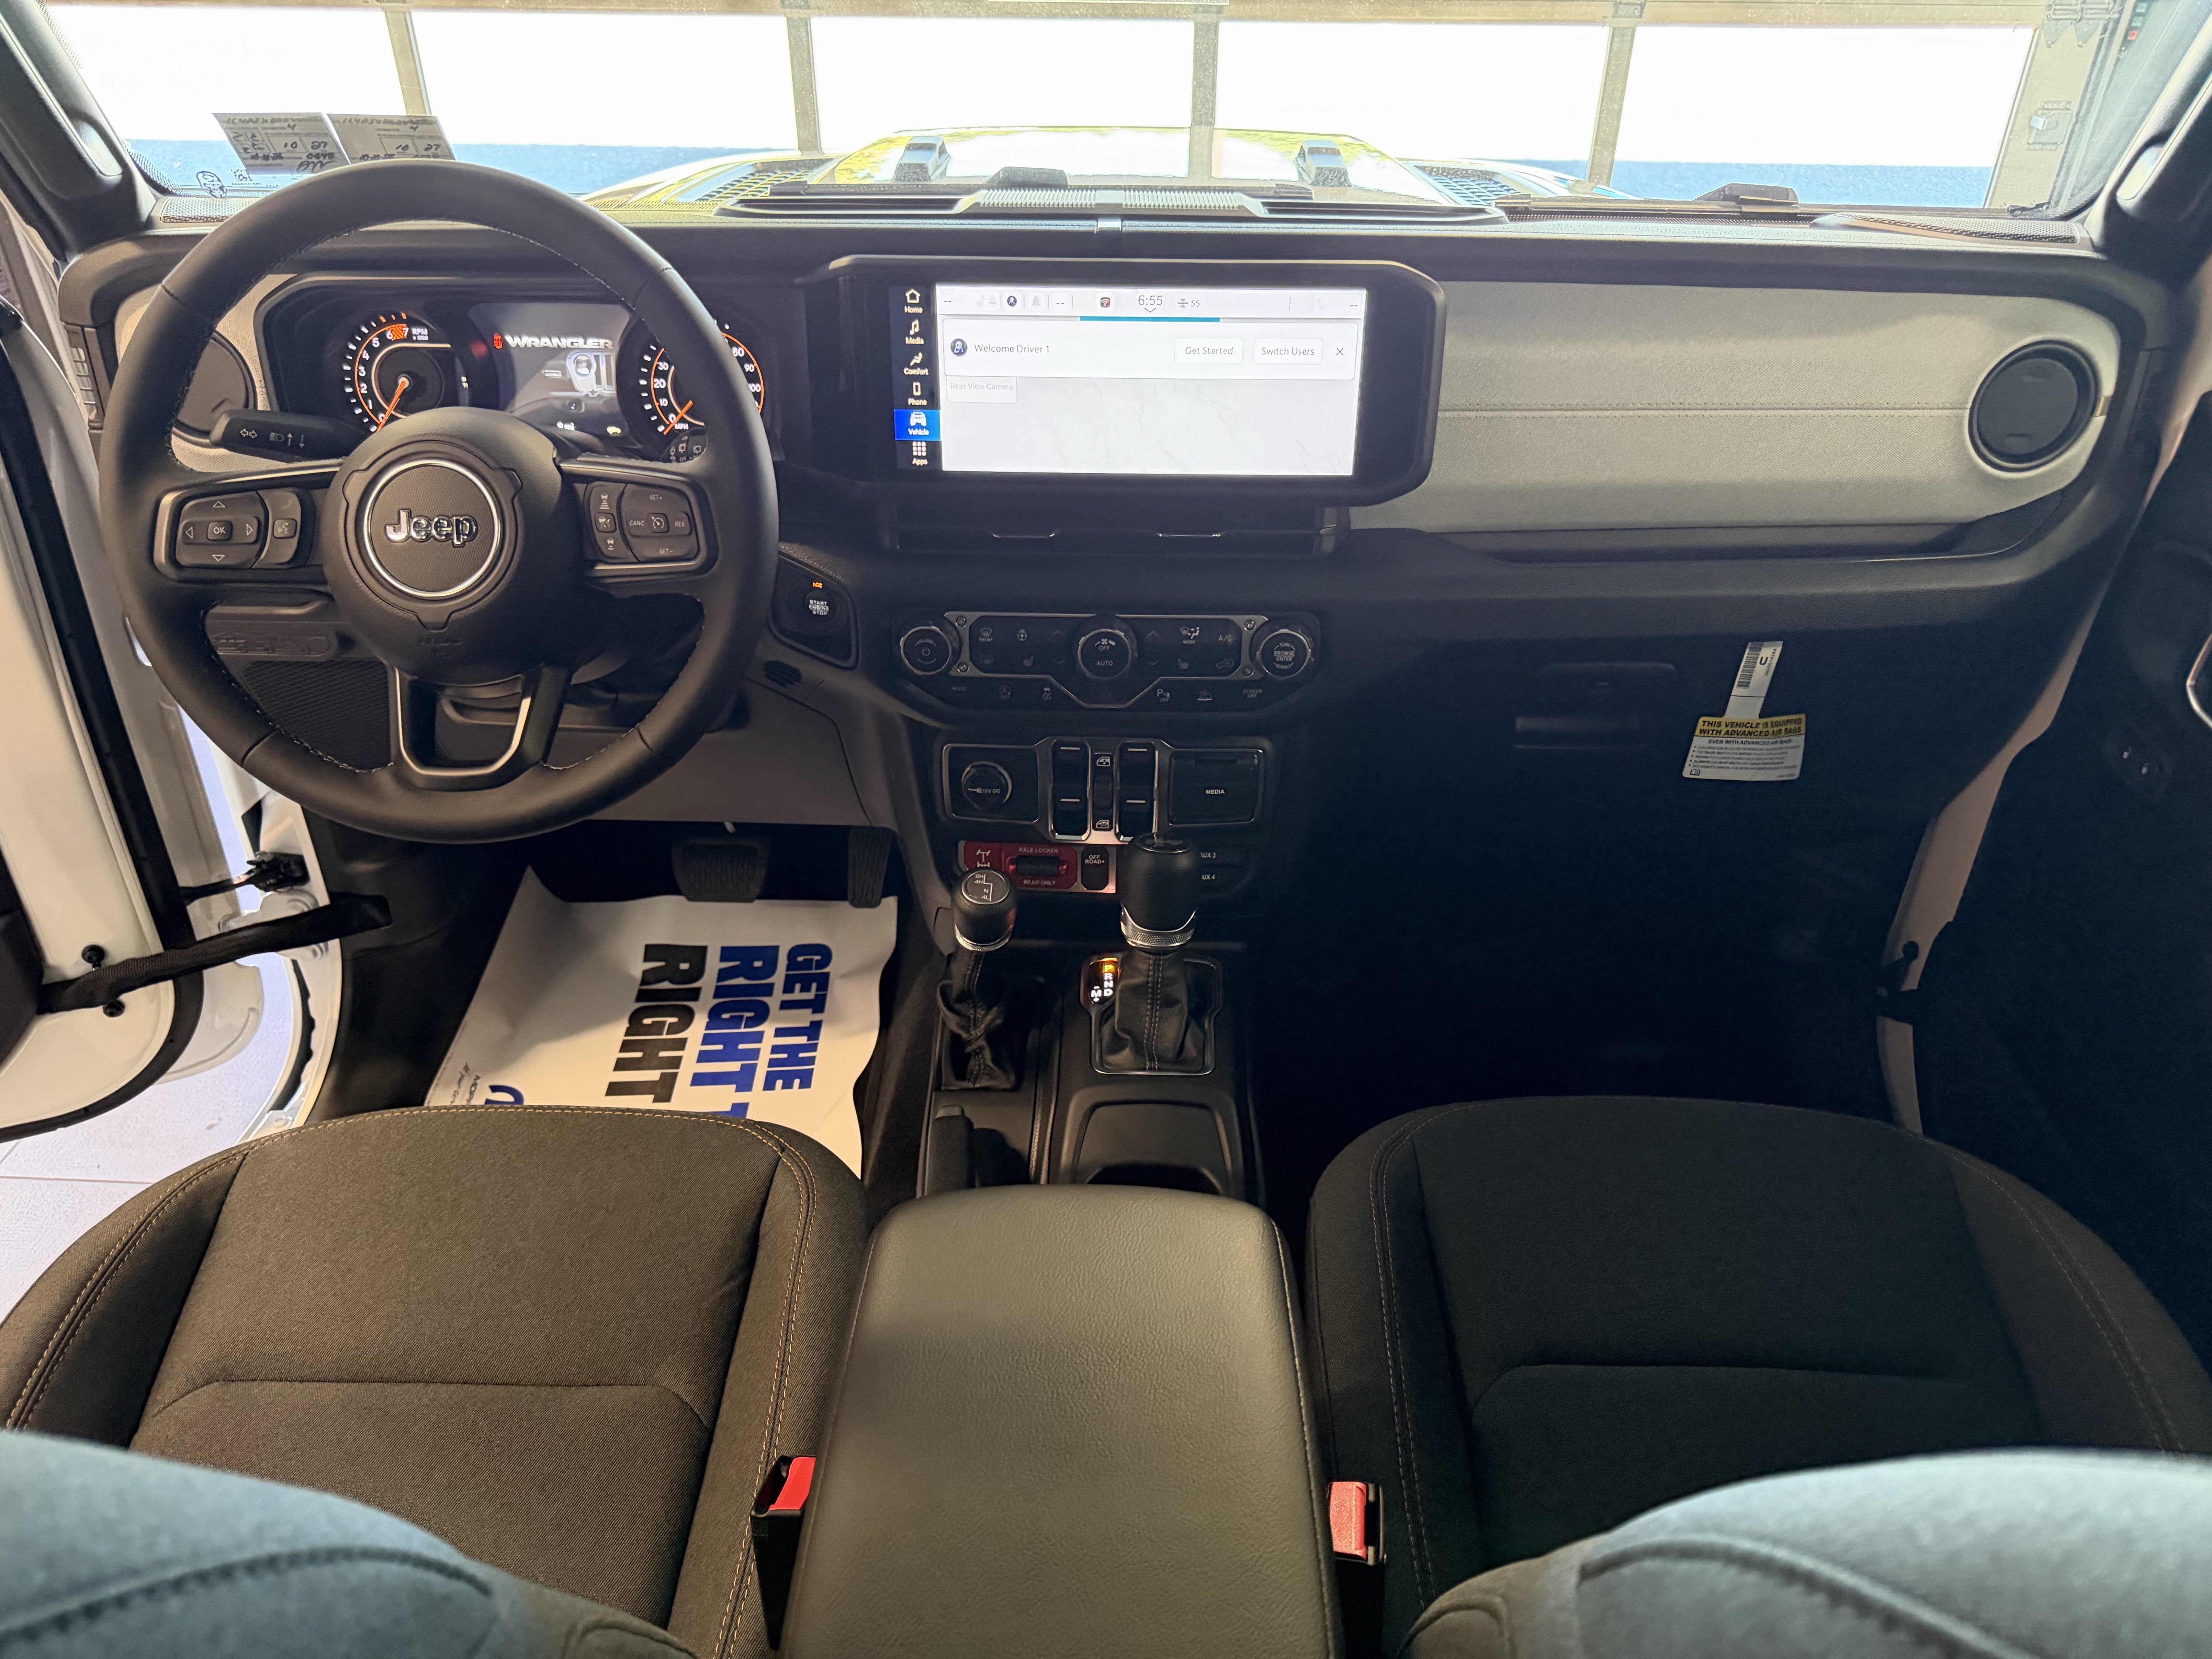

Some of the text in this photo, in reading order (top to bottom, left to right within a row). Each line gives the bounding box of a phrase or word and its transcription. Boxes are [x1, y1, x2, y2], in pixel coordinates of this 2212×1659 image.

[1138, 295, 1163, 306] 6:55
[904, 305, 923, 313] Home
[386, 330, 393, 339] 6
[402, 327, 409, 337] 7
[372, 338, 380, 347] 5
[505, 335, 614, 349] WRANGLER
[905, 337, 924, 345] Media
[732, 347, 745, 357] 80
[974, 344, 1015, 353] Welcome
[1017, 345, 1043, 354] Driver
[1185, 346, 1233, 355] Get Started
[1261, 347, 1315, 356] Switch Users
[362, 350, 369, 360] 4
[658, 362, 669, 371] 30
[744, 363, 755, 373] 90
[358, 367, 366, 376] 3
[903, 367, 929, 376] Comfort
[654, 378, 666, 388] 20
[986, 383, 1013, 391] Camera
[360, 384, 368, 394] 2
[368, 399, 373, 409] 1
[659, 398, 668, 407] 10
[908, 398, 927, 406] Phone
[668, 413, 677, 423] 0
[675, 422, 689, 431] MPH
[912, 457, 928, 466] Apps
[386, 508, 478, 548] Jeep
[1759, 656, 1769, 665] U
[1702, 720, 1723, 728] THIS
[1724, 721, 1760, 729] VEHICLE
[1770, 718, 1802, 728] EQUIPPED
[1104, 964, 1113, 972] P
[1091, 989, 1102, 998] M
[1104, 989, 1113, 997] D
[690, 945, 780, 1093] RIGHT
[762, 943, 833, 1091] GET THE
[605, 943, 708, 1103] RIGHT
